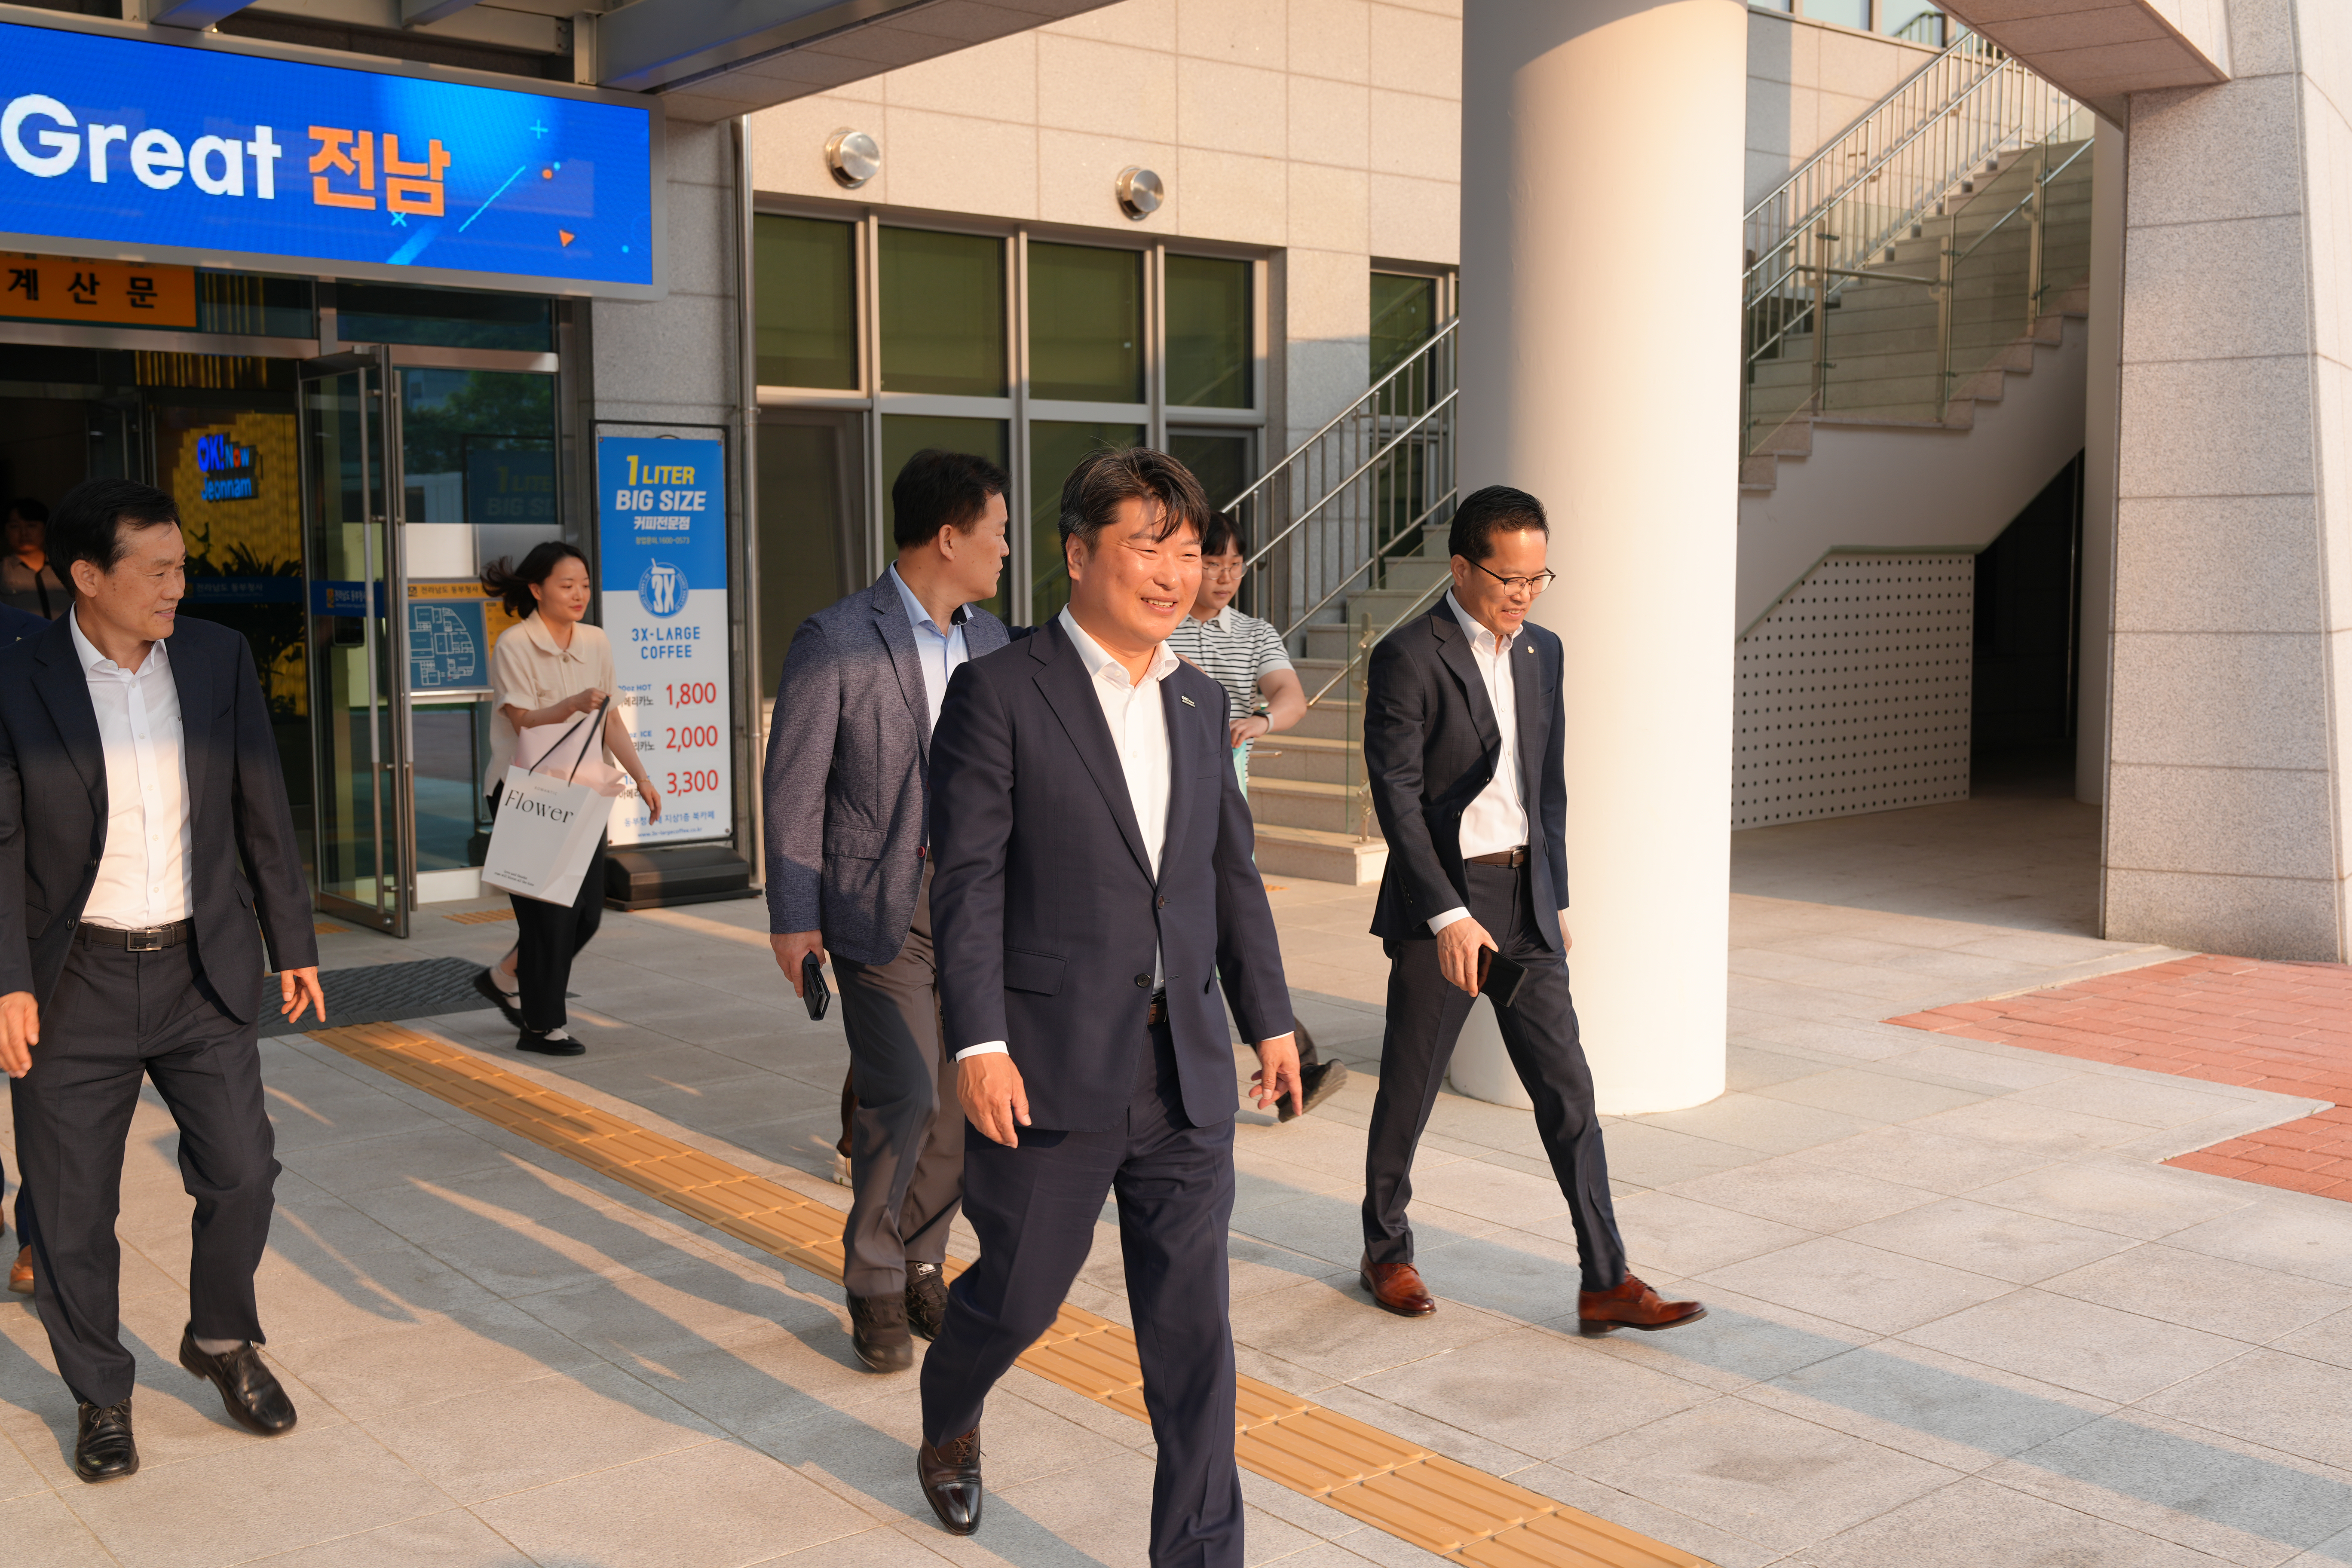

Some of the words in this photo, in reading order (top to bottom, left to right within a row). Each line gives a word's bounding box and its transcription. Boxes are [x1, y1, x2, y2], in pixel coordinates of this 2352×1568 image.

[0, 94, 282, 199] Great
[308, 125, 450, 217] 전남
[197, 433, 225, 472] OK!
[627, 455, 639, 486] 1
[643, 466, 695, 485] LITER
[201, 476, 252, 501] Jeonnam
[616, 490, 654, 511] BIG
[659, 490, 707, 511] SIZE
[634, 516, 690, 530] 커피전문점
[421, 585, 448, 594] 전라남도
[452, 584, 478, 594] 동부청사
[632, 627, 700, 642] 3X-LARGE
[641, 645, 692, 660] COFFEE
[622, 695, 654, 707] 메리카노
[666, 682, 717, 709] 1,800
[666, 726, 718, 753] 2,000
[667, 769, 719, 797] 3,300
[505, 789, 573, 823] Flower
